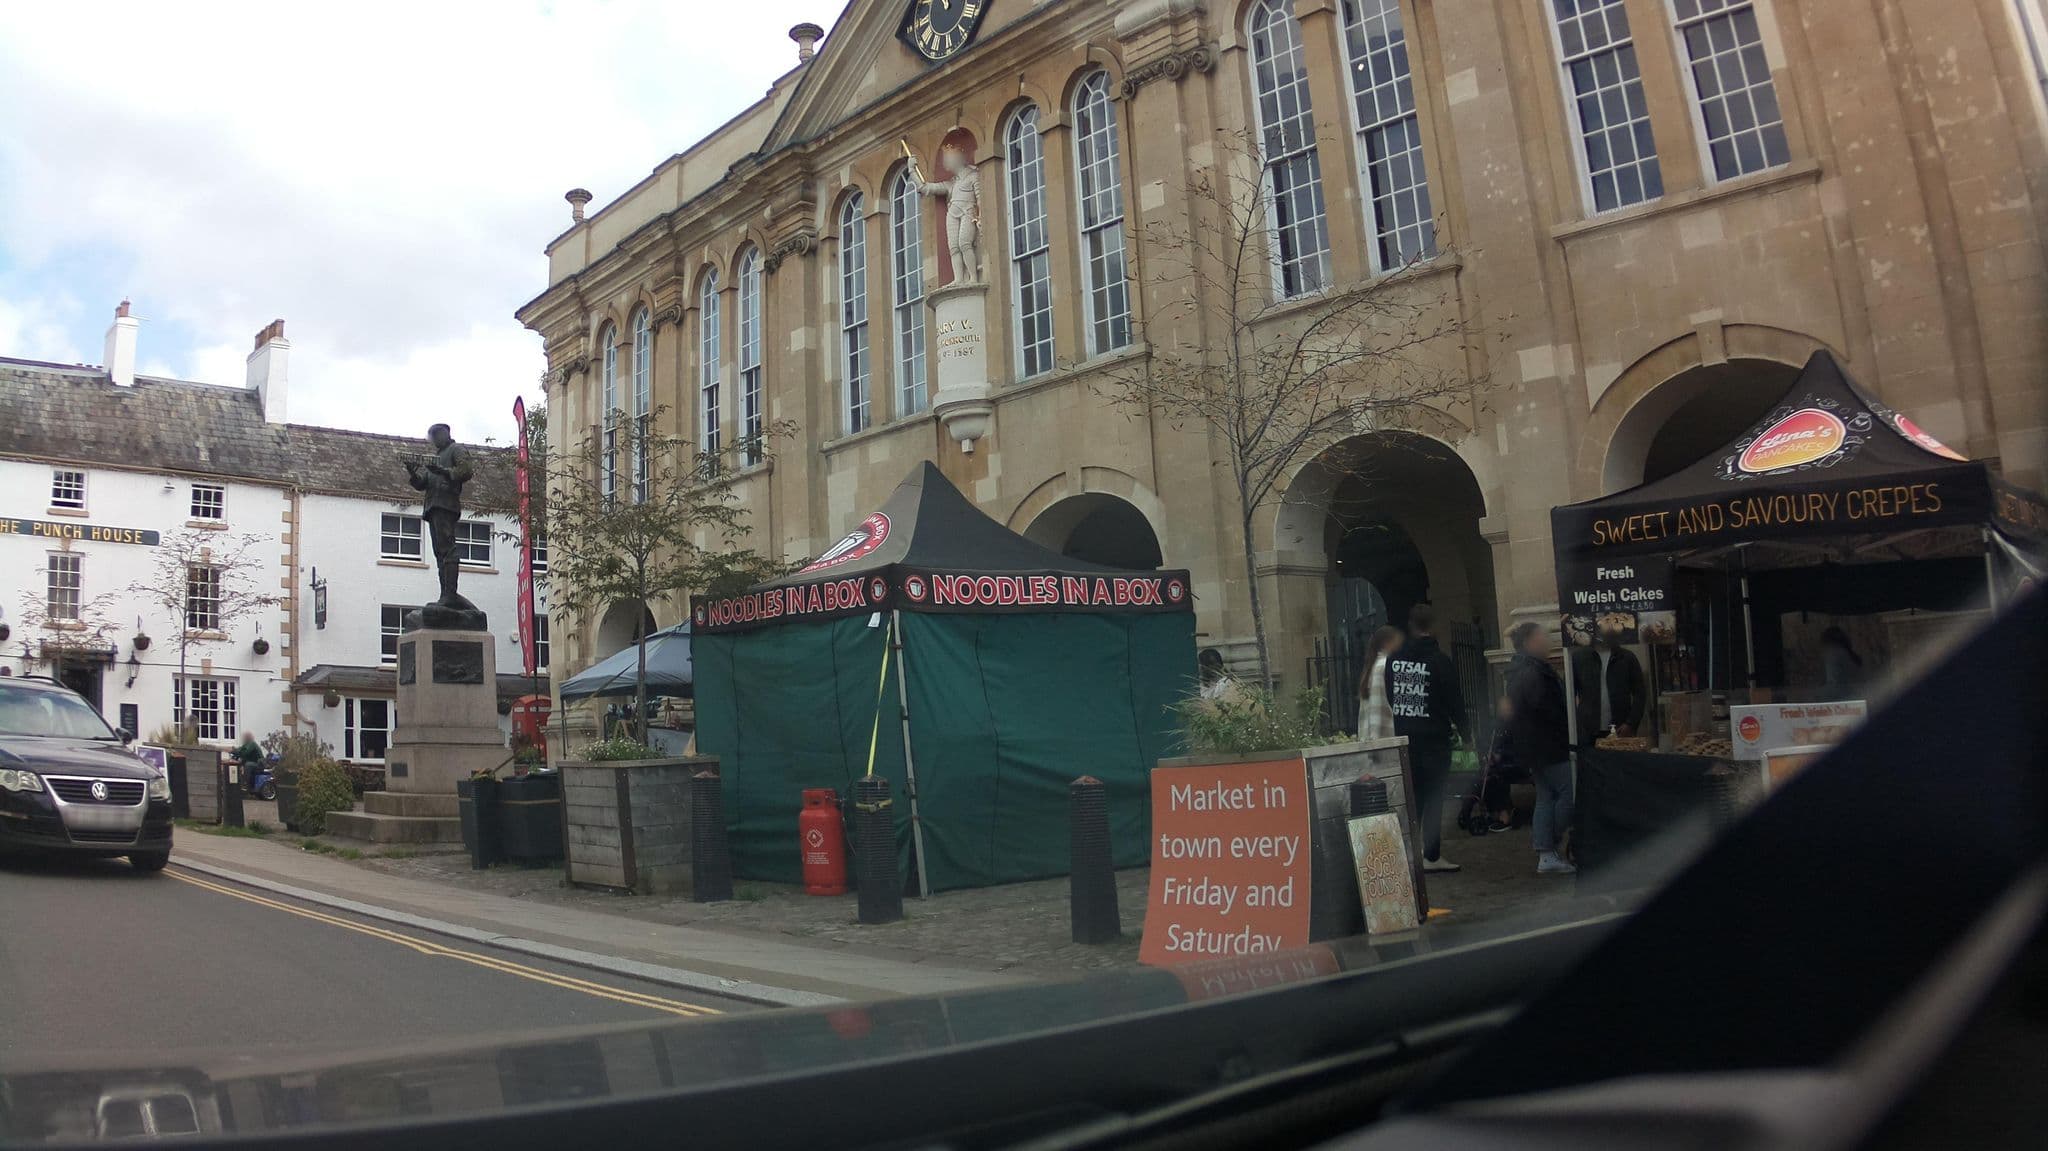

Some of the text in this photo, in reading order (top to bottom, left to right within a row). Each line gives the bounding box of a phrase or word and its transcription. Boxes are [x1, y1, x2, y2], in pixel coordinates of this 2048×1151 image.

[1752, 441, 1825, 461] PANCAKES
[1592, 483, 1942, 545] SWEET AND SAVOURY CREPES
[33, 522, 83, 539] PUNCH
[91, 527, 145, 544] HOUSE
[1596, 565, 1635, 580] Fresh
[708, 577, 867, 627] NOODLES IN A BOX
[932, 575, 1164, 606] NOODLES IN A BOX
[1573, 587, 1664, 604] Welsh Cakes
[1171, 780, 1286, 811] Market in
[1160, 833, 1300, 867] town every
[1163, 876, 1293, 915] Friday and
[1164, 923, 1282, 955] Saturday
